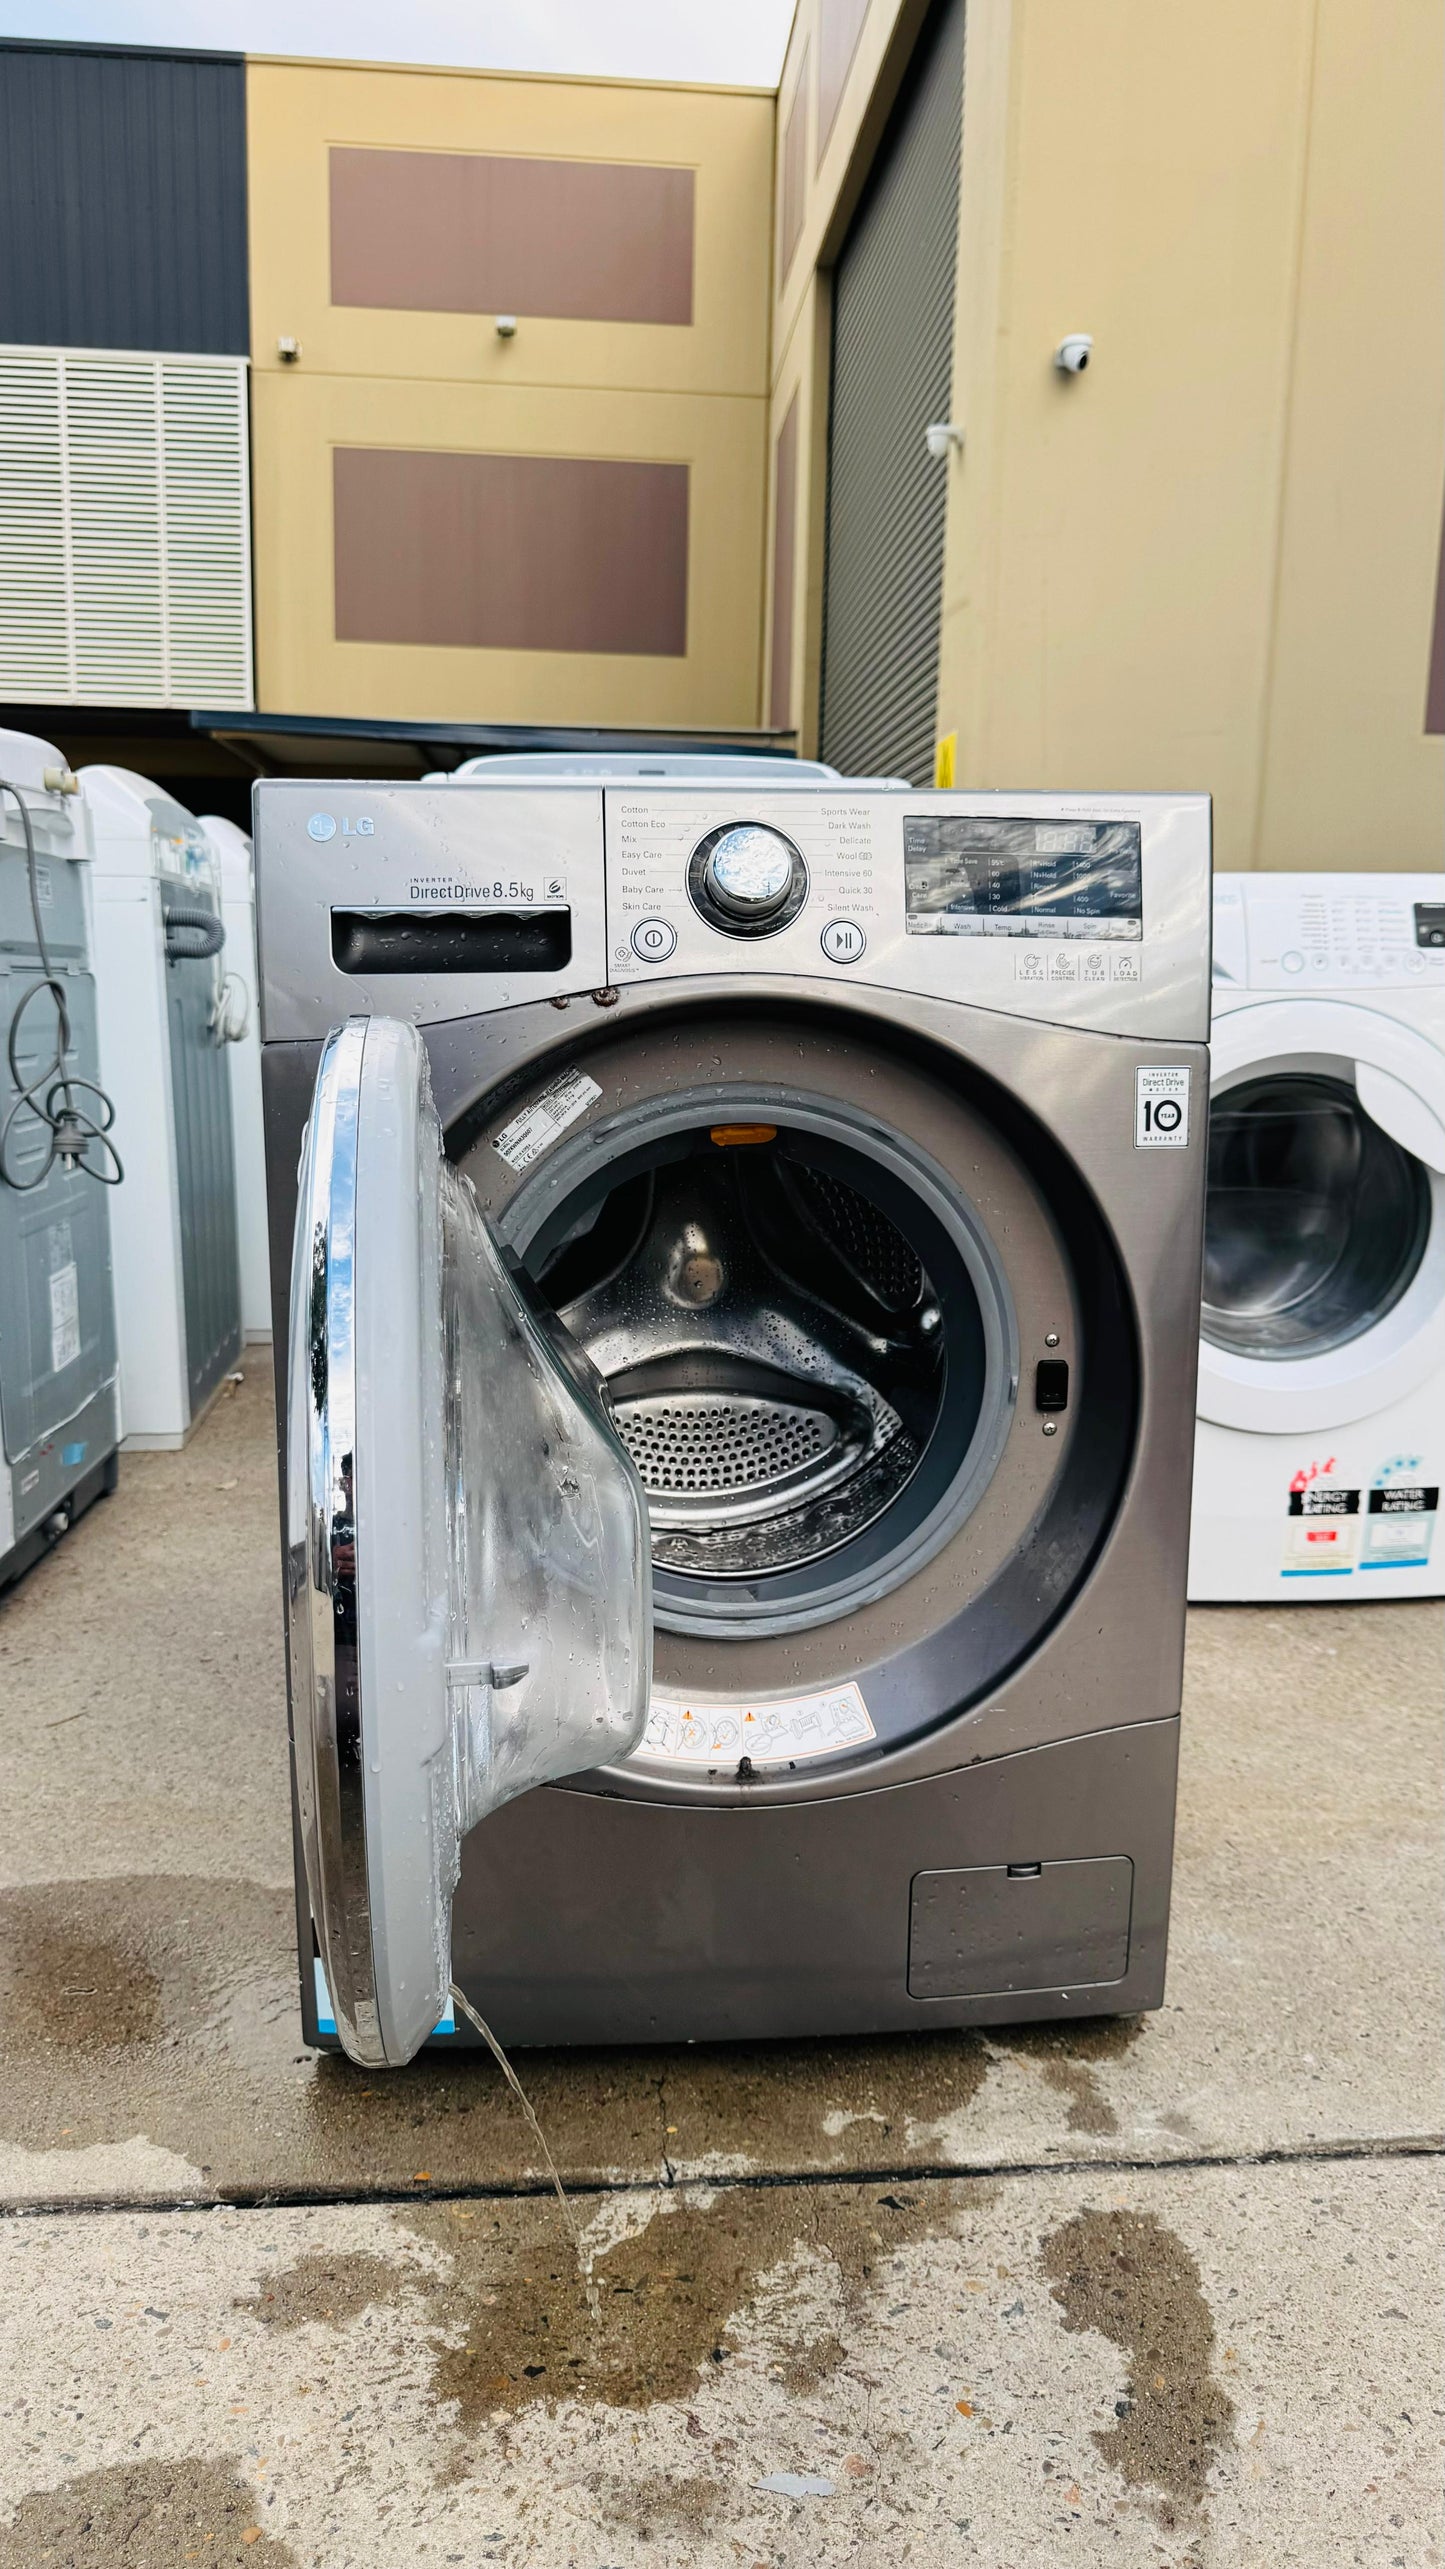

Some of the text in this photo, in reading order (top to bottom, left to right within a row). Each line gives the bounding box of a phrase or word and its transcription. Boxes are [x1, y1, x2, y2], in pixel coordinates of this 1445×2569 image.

[621, 806, 649, 814] Cotton
[821, 808, 871, 816] Sports Wear
[342, 817, 375, 836] LG
[621, 820, 666, 828] Cotton Eco
[828, 822, 871, 830] Dark Wash
[621, 835, 637, 843] Mix
[839, 836, 872, 844] Delicate
[622, 851, 662, 859] Easy Care
[836, 852, 858, 860] Wool
[622, 868, 646, 876] Duvet
[824, 869, 873, 877] Intensive 60
[622, 885, 643, 894] Baby
[838, 887, 861, 895] Quick
[827, 904, 874, 912] Silent Wash
[1086, 907, 1100, 915] Spin
[1142, 1078, 1184, 1086] Direct Drive
[1144, 1100, 1182, 1132] 10
[499, 1133, 507, 1141] LG
[516, 1113, 527, 1124] FULLY
[1383, 1489, 1425, 1500] WATER
[1382, 1500, 1425, 1512] RATING
